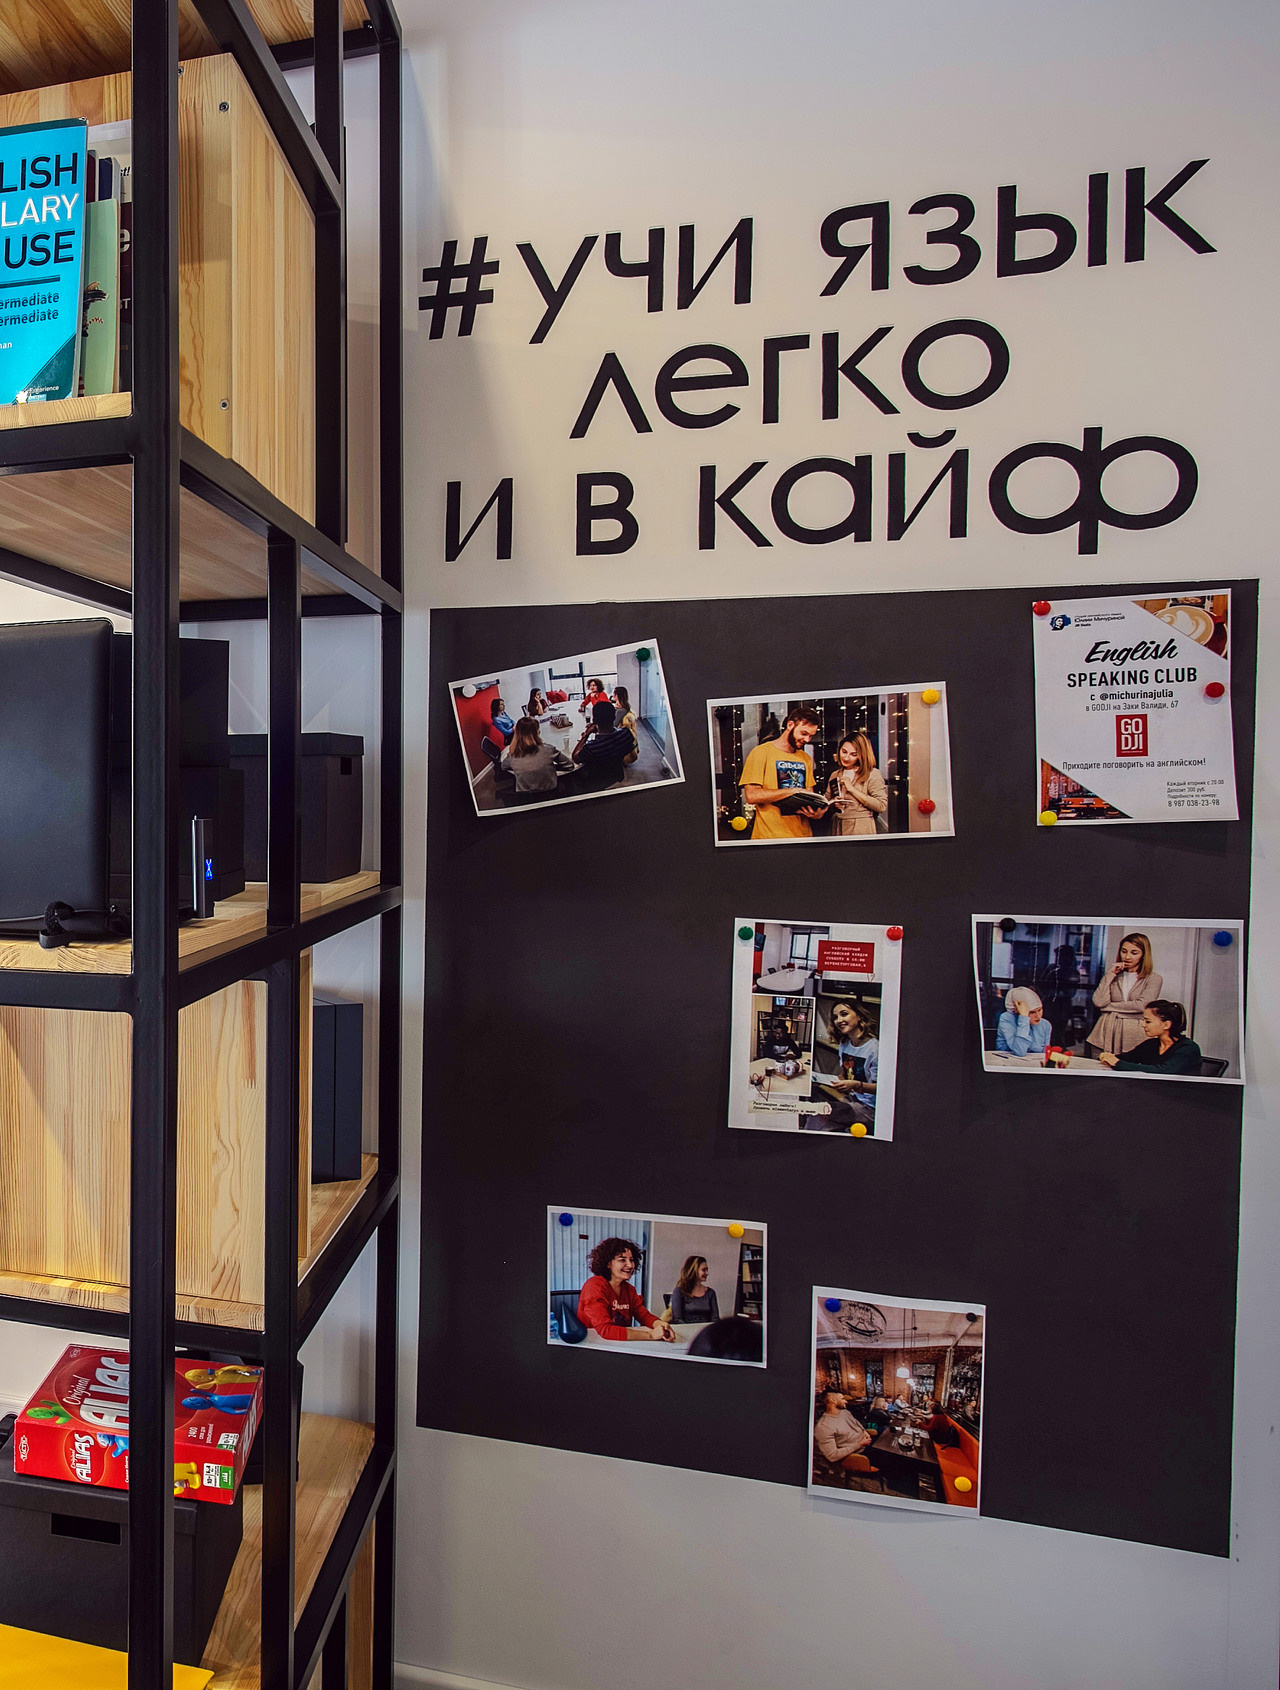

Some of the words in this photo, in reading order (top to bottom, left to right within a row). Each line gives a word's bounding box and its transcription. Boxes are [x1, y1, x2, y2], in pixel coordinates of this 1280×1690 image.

[4, 229, 75, 269] USE
[569, 317, 1010, 440] легко
[698, 426, 1199, 556] кайф
[1085, 638, 1178, 666] English
[1067, 670, 1149, 688] SPEAKING
[1154, 667, 1198, 683] CLUB
[1092, 703, 1111, 711] GODJI
[1100, 689, 1174, 701] @michurinajulia
[1121, 718, 1142, 734] GO
[1122, 734, 1143, 750] DJI
[1062, 762, 1100, 771] Приходите
[1103, 760, 1144, 770] поговорить
[1157, 758, 1206, 768] английском!
[63, 1374, 91, 1405] Original
[74, 1434, 94, 1482] ALIAS
